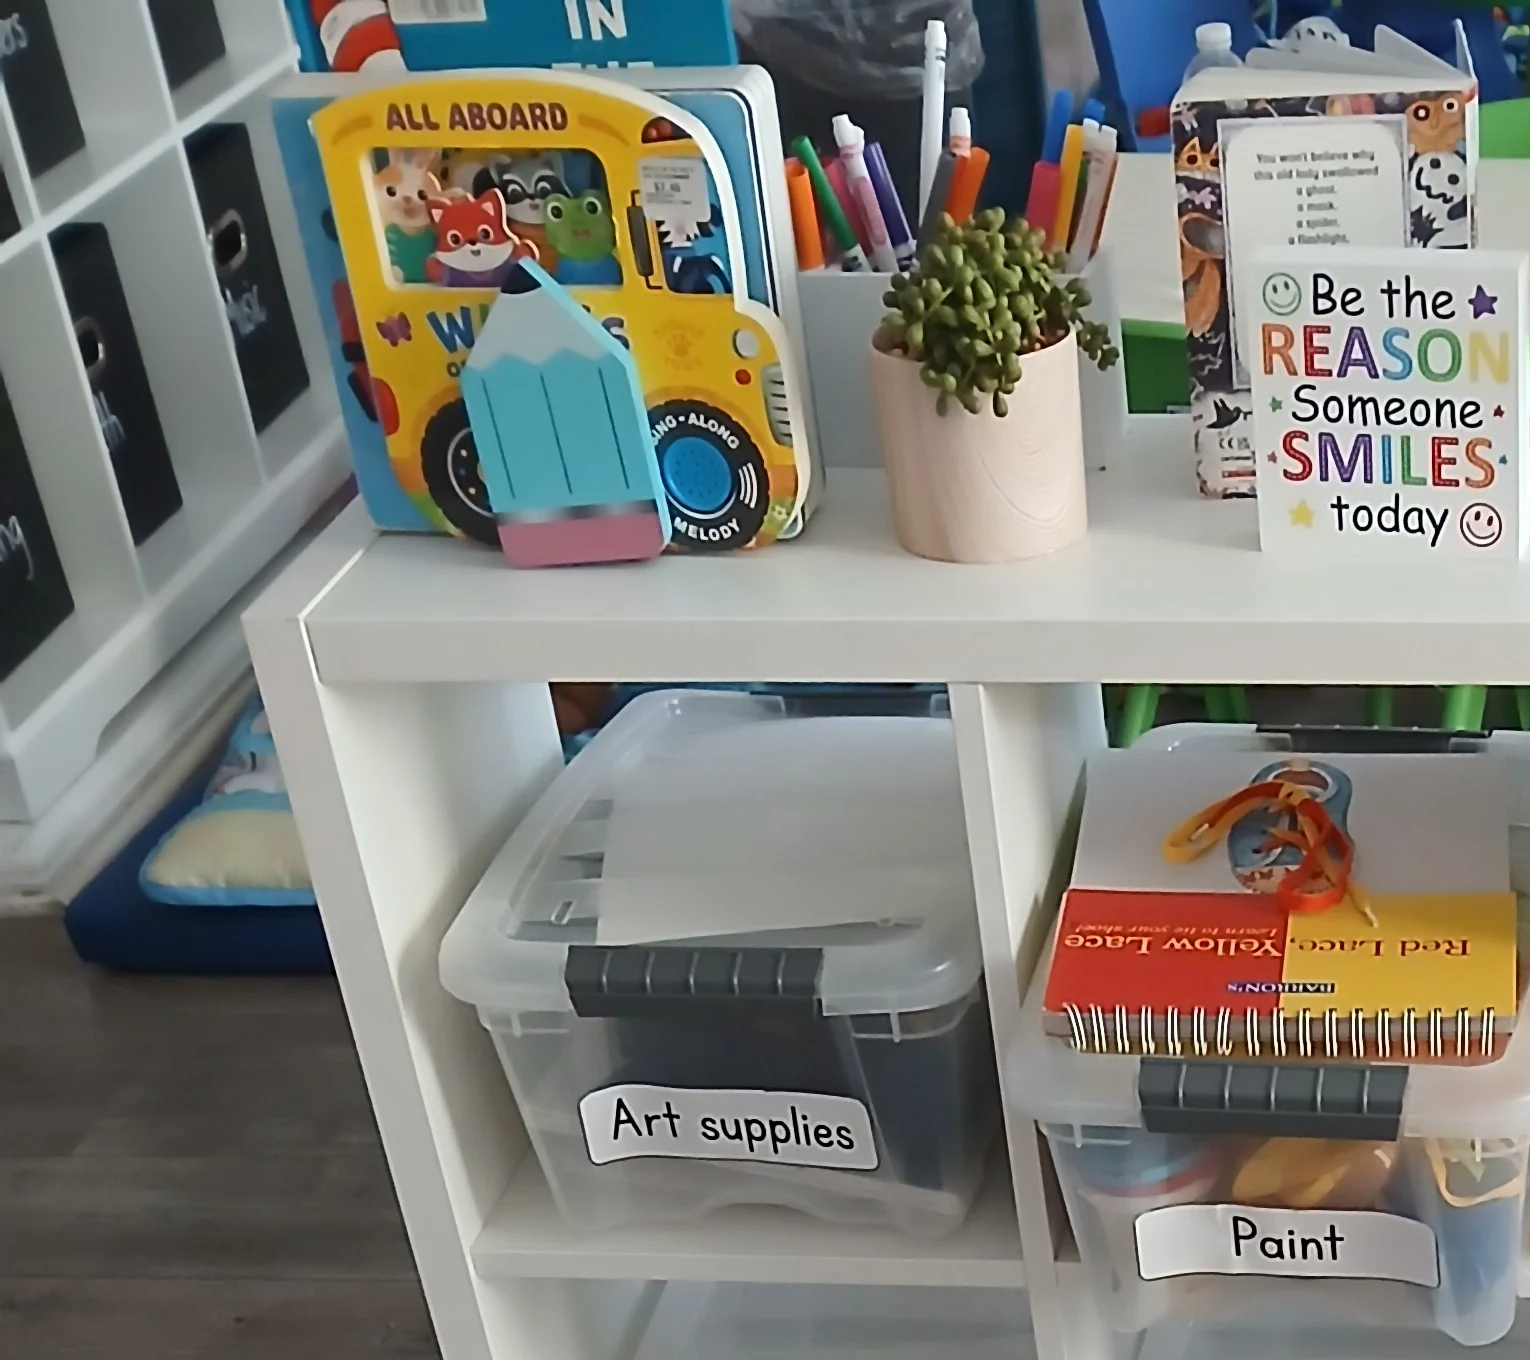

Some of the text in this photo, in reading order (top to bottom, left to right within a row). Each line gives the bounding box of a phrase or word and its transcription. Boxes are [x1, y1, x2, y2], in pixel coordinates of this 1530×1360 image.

[564, 0, 628, 41] IN
[386, 101, 569, 132] ALL ABOARD
[1312, 273, 1456, 320] Be the
[1261, 322, 1510, 384] REASON
[1291, 383, 1484, 429] Someone
[1281, 429, 1497, 489] SMILES
[674, 516, 740, 541] MELODY
[1330, 493, 1450, 548] today
[1064, 934, 1471, 957] Red Lace, Yellow Lace
[612, 1097, 855, 1154] Art supplies
[1232, 1215, 1345, 1261] Paint
